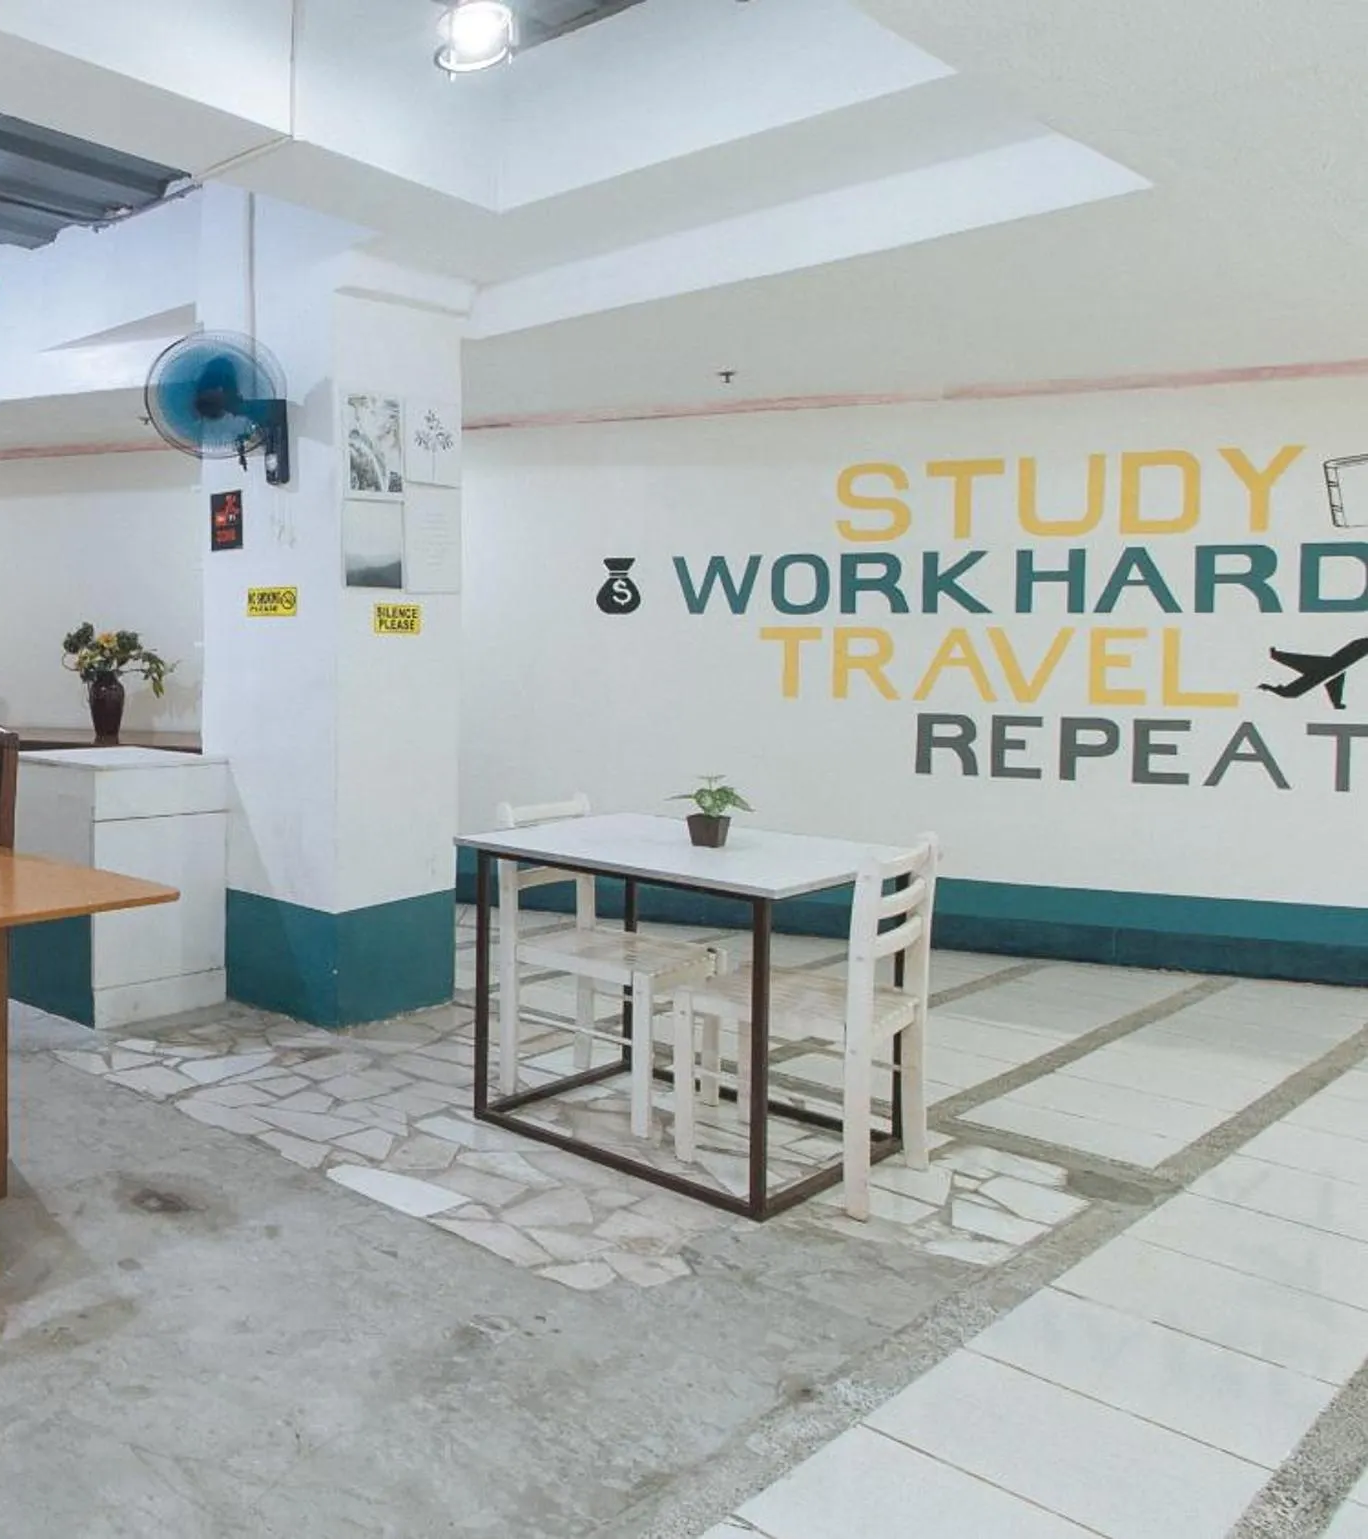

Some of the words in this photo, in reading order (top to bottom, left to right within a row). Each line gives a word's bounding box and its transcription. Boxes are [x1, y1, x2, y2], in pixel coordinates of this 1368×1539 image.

[835, 444, 1304, 543] STUDY
[378, 619, 415, 630] PLEASE
[760, 626, 1240, 709] TRAVEL
[913, 712, 1368, 793] REPEAT
